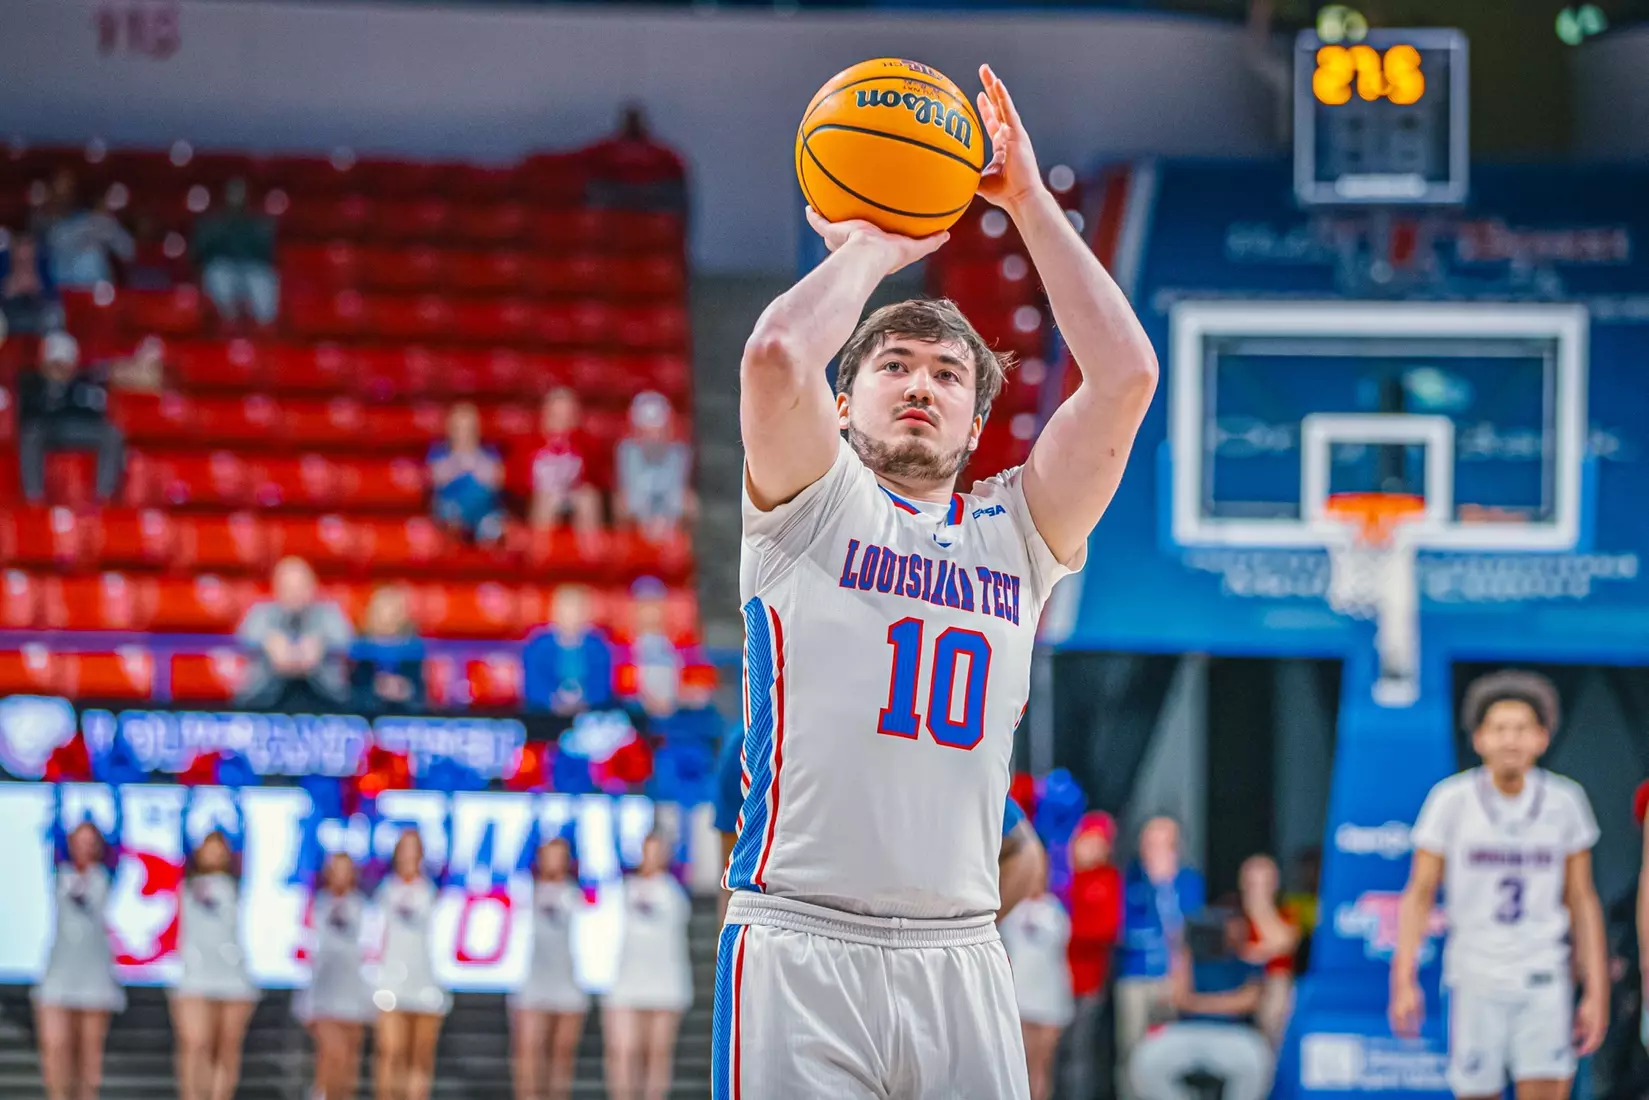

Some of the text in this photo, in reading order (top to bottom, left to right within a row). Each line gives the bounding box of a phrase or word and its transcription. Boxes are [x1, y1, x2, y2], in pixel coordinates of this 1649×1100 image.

[855, 89, 971, 149] Wilson
[839, 538, 1021, 628] LOUISIAA TECH
[876, 615, 993, 752] 10
[1495, 876, 1526, 925] 3
